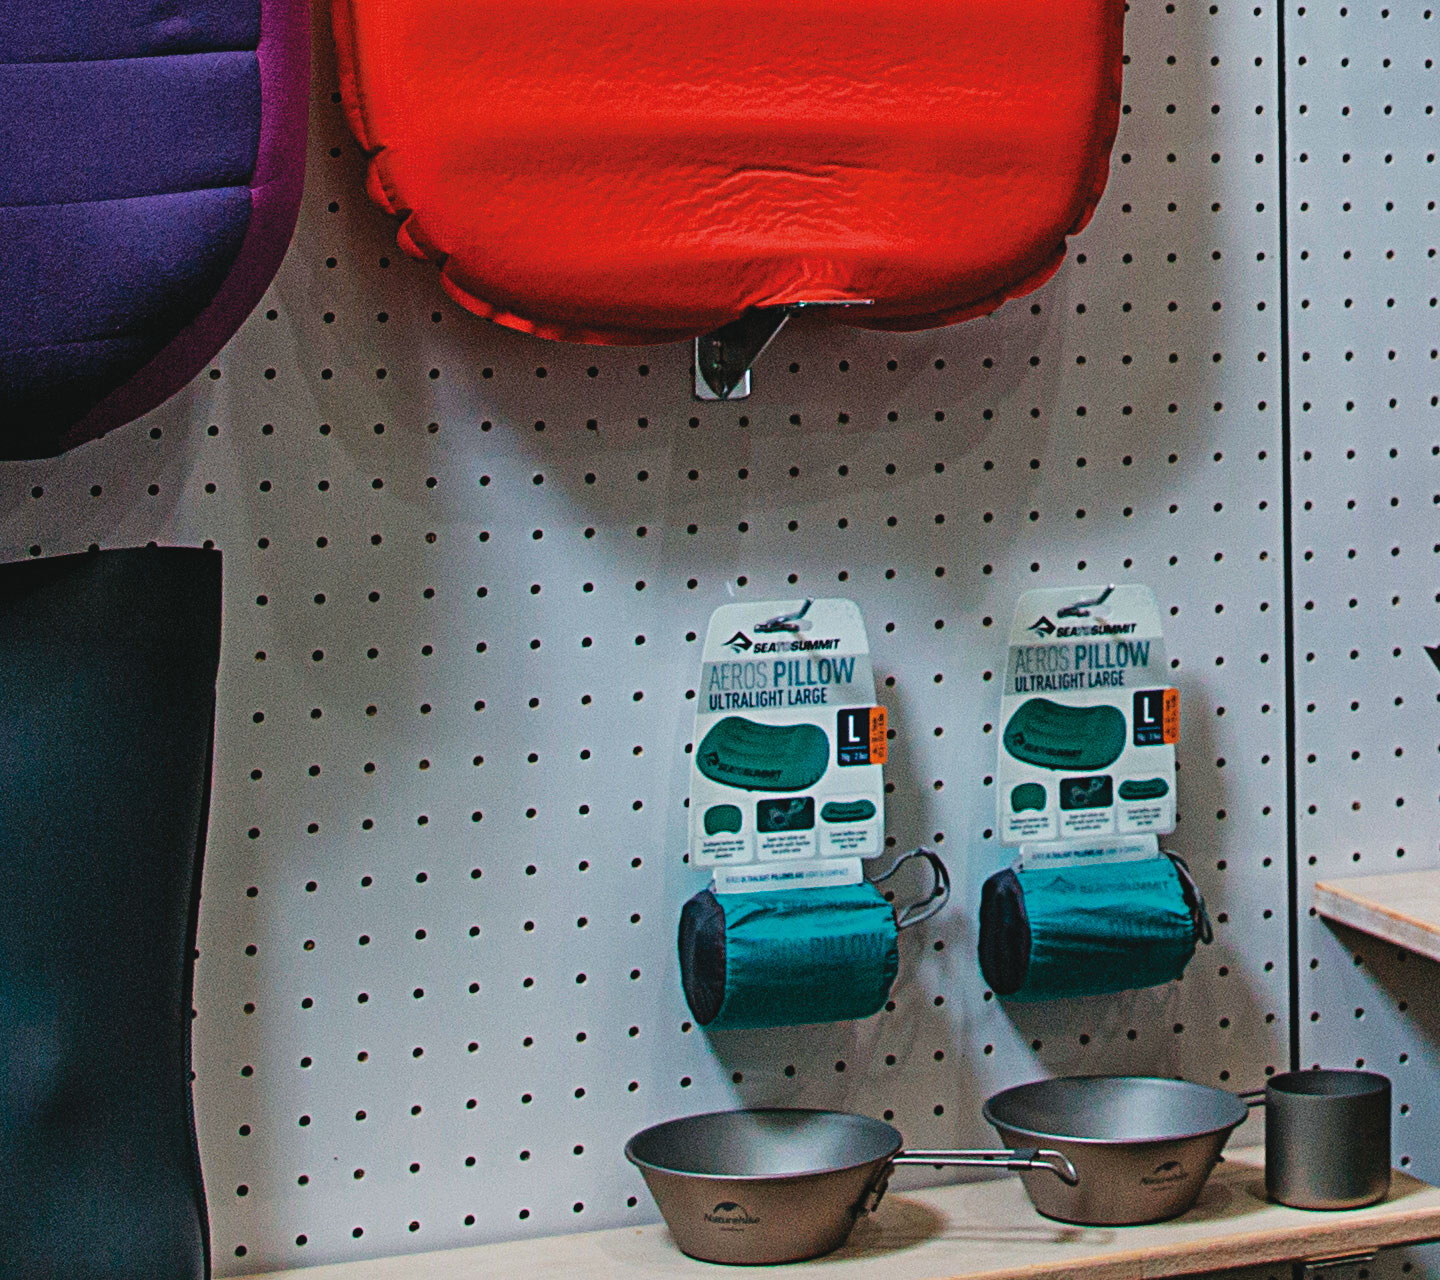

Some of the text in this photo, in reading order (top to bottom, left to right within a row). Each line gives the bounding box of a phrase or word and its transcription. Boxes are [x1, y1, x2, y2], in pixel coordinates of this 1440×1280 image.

[1015, 640, 1151, 674] AEROS PILLOW
[709, 656, 856, 691] AEROS PILLOW
[1014, 669, 1126, 692] ULTRALIGHT LARGE
[709, 687, 828, 711] ULTRALIGHT LARGE
[1143, 696, 1155, 724] L
[848, 714, 861, 743] L
